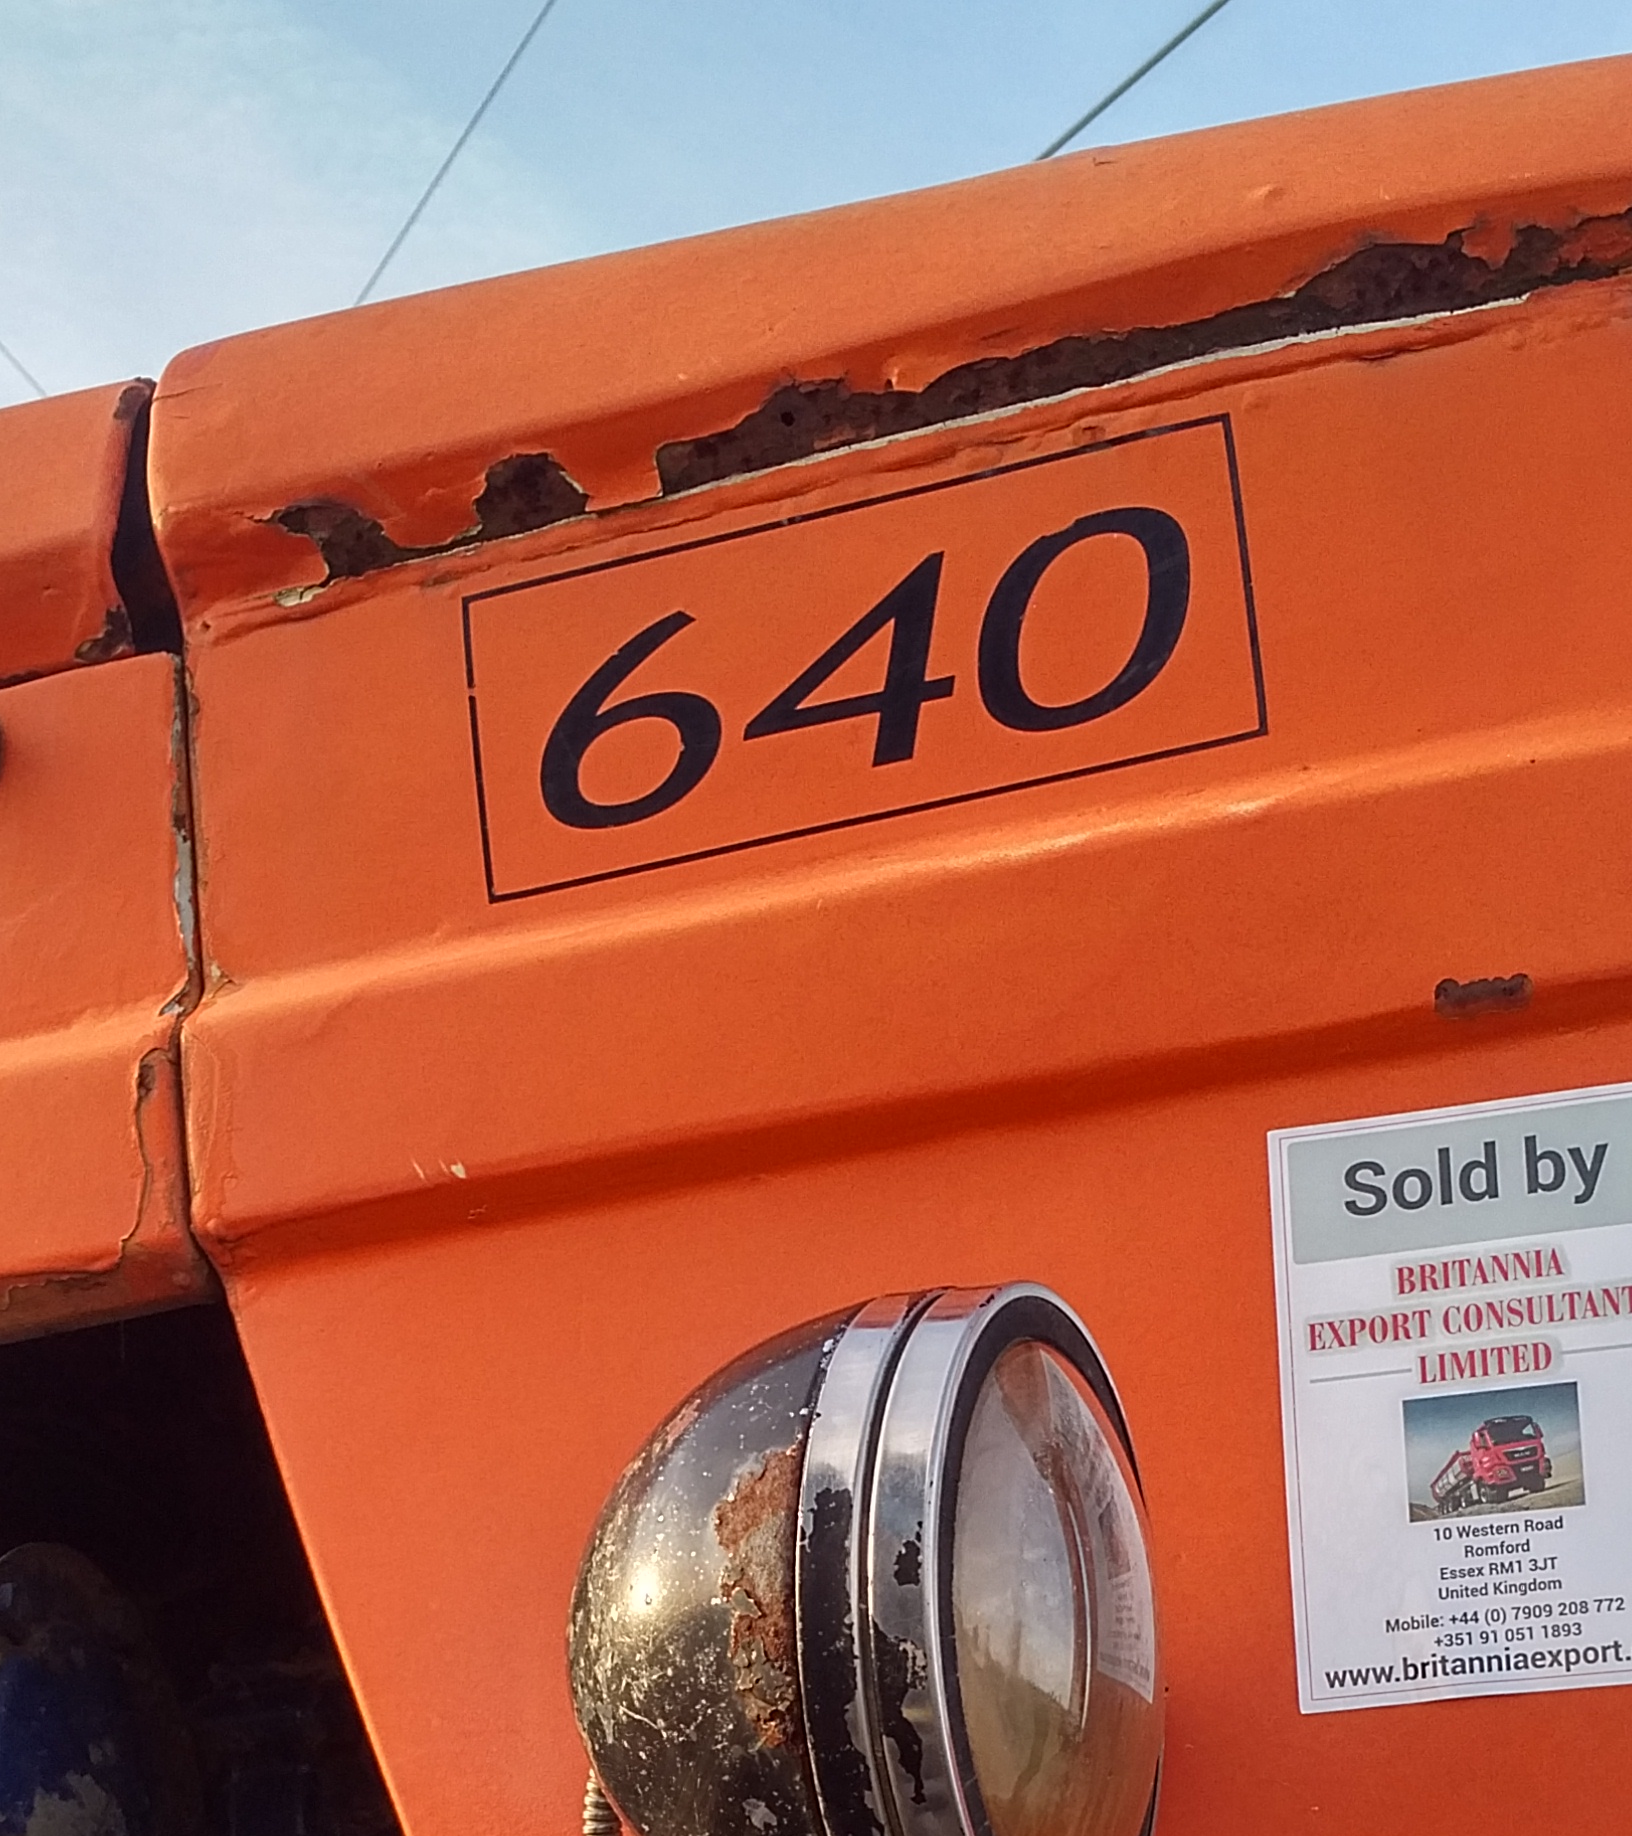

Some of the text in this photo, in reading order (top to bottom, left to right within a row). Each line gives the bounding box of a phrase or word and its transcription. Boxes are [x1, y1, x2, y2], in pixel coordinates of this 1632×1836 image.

[540, 506, 1191, 830] 640
[1344, 1134, 1610, 1217] Sold by
[1395, 1247, 1566, 1296] BRITANNIA
[1307, 1309, 1432, 1352] EXPORT
[1418, 1341, 1553, 1385] LIMITED
[1433, 1515, 1565, 1542] 10 Western Road
[1463, 1539, 1532, 1559] Romford
[1439, 1556, 1559, 1581] Essex RM1 3JT
[1437, 1576, 1564, 1601] United Kingdom
[1384, 1596, 1627, 1634] Mobile: +44 (0) 7909 208 772
[1433, 1621, 1584, 1648] +351 91 051 1893
